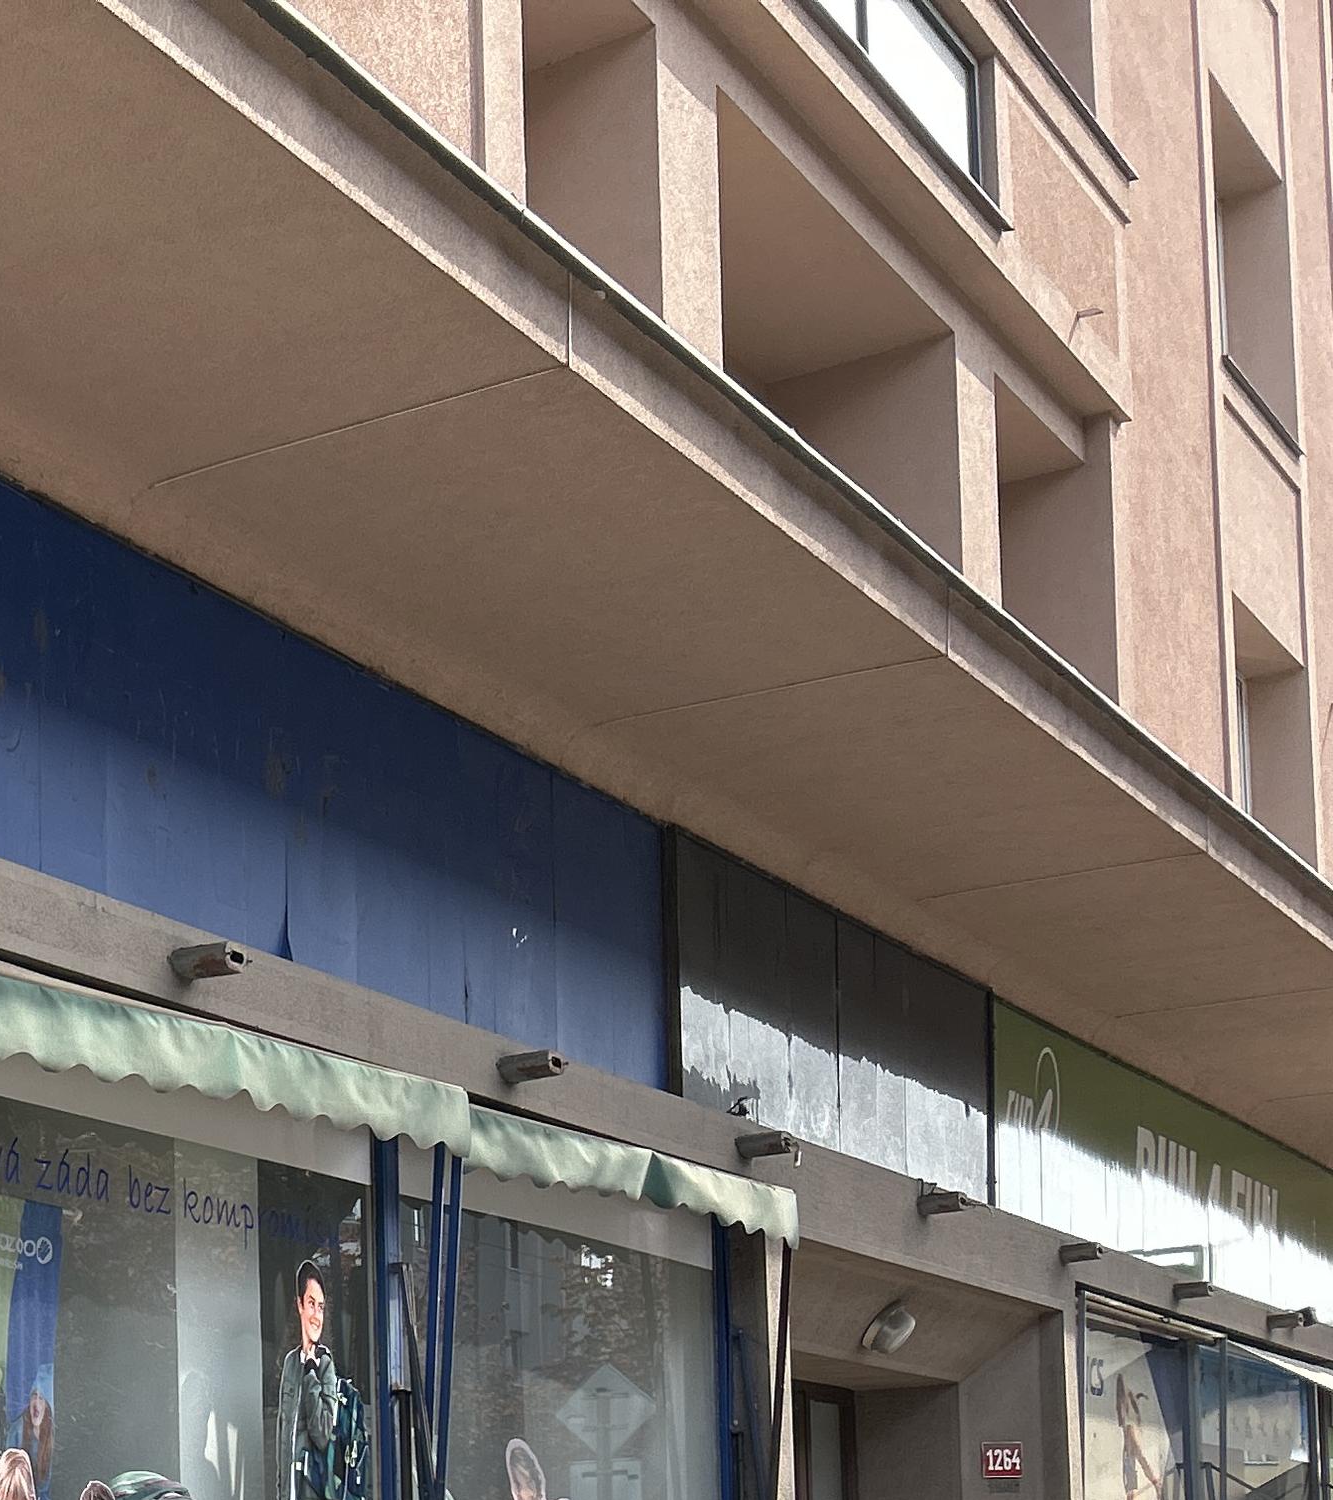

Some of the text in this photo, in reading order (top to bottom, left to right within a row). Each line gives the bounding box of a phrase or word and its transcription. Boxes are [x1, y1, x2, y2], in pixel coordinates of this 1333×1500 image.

[33, 1149, 110, 1204] záda
[128, 1164, 173, 1216] bez
[986, 1448, 1021, 1471] 1264
